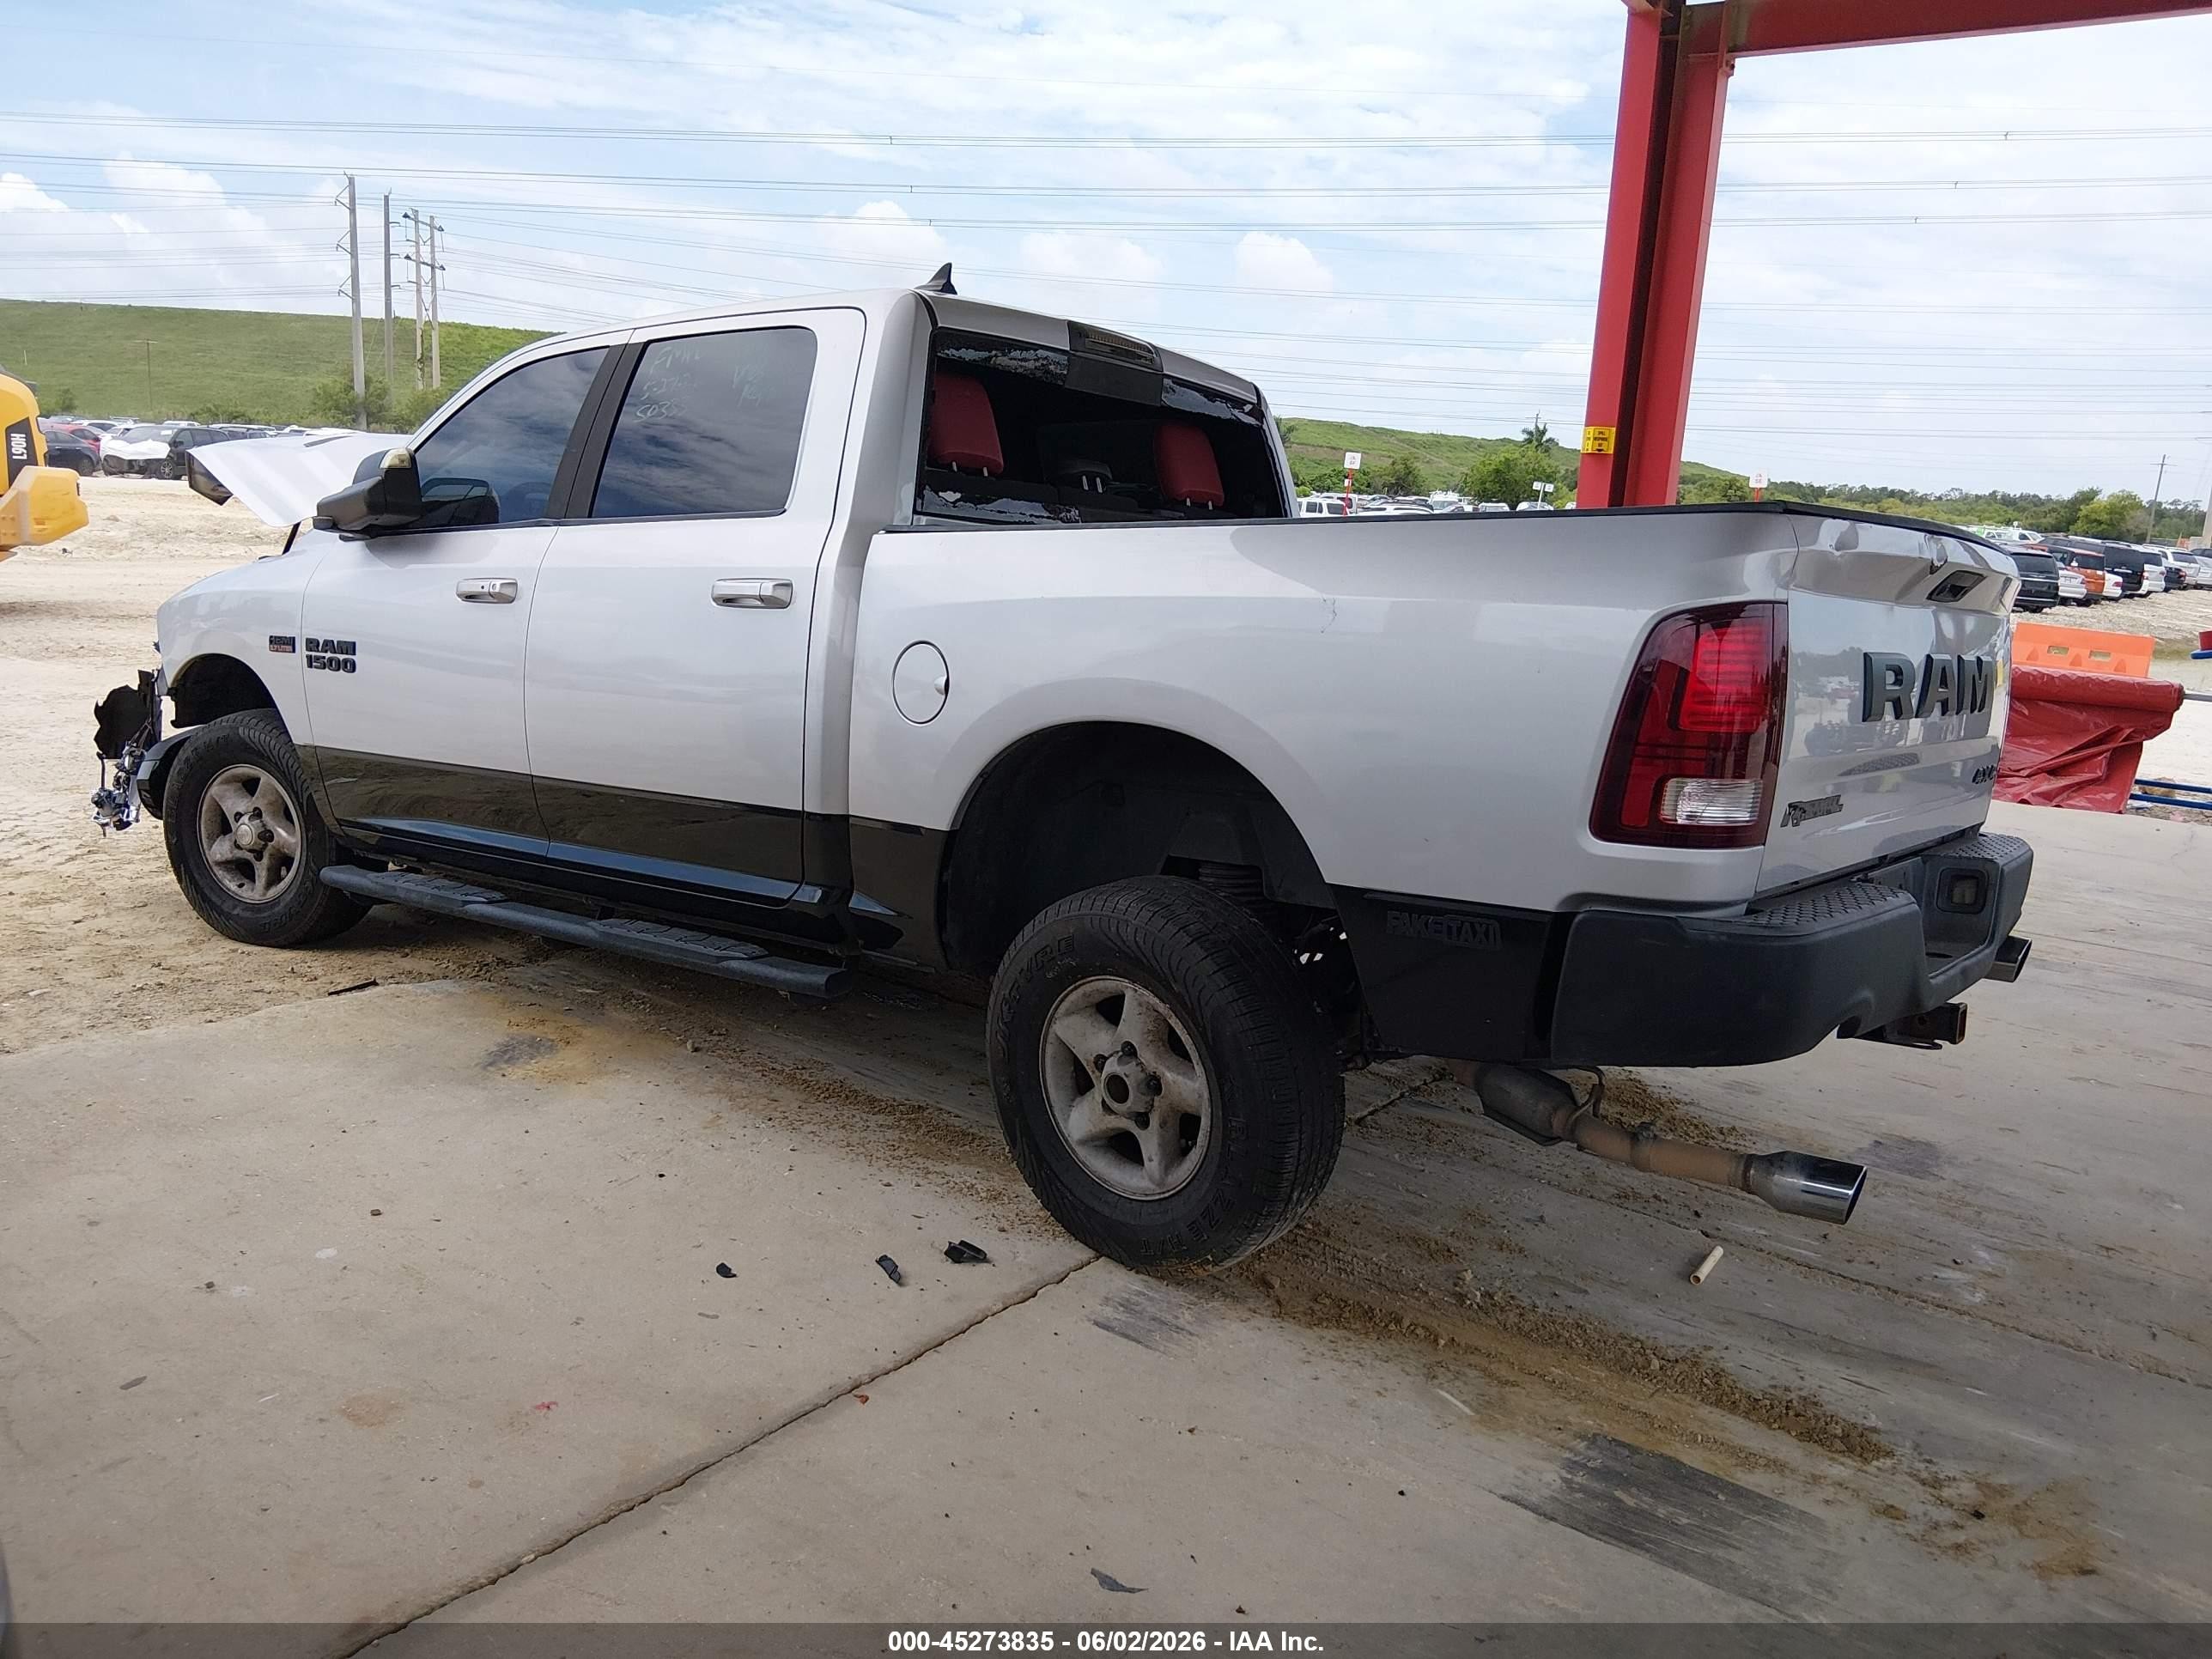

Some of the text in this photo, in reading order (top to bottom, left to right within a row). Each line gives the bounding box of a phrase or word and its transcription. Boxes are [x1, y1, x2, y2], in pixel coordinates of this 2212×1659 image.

[10, 433, 27, 459] L90H
[305, 637, 357, 656] RAM
[305, 654, 357, 674] 1500
[1862, 651, 1995, 722] RAM
